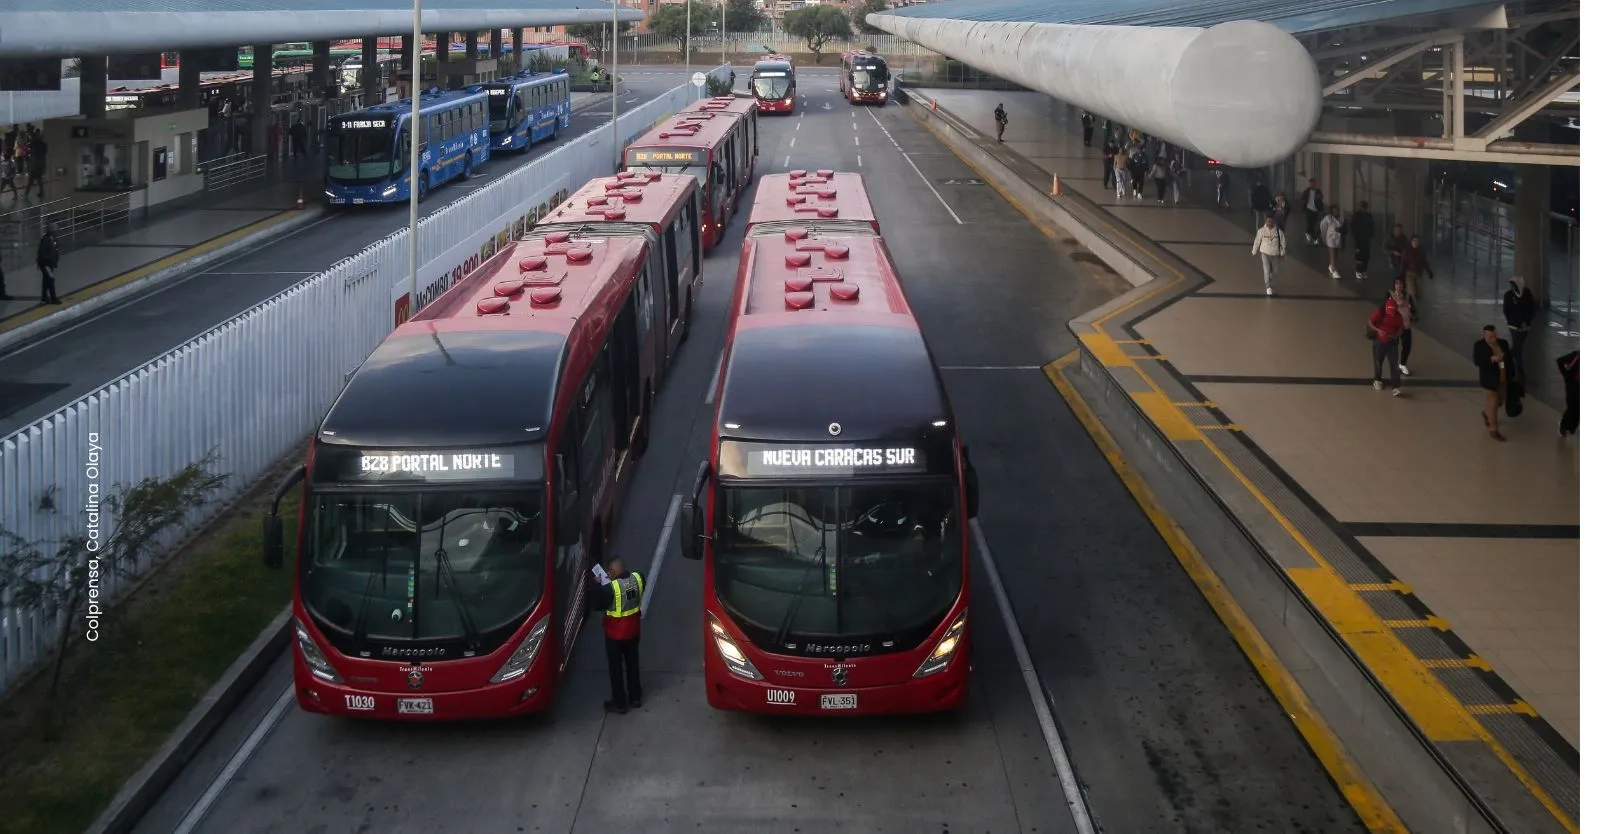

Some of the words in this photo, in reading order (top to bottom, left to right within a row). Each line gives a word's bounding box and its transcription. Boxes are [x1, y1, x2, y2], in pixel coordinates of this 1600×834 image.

[652, 152, 673, 160] PORTAL
[674, 152, 693, 160] NORTE
[361, 455, 389, 471] B28
[390, 454, 449, 472] PORTAL
[452, 453, 502, 470] NORTE
[762, 449, 811, 466] NUEVA
[814, 448, 883, 466] CARACAS
[885, 447, 915, 465] SUR
[382, 646, 447, 657] Marcopolo
[805, 643, 871, 654] Marcopolo
[344, 694, 375, 708] T1030
[767, 689, 795, 703] U1009
